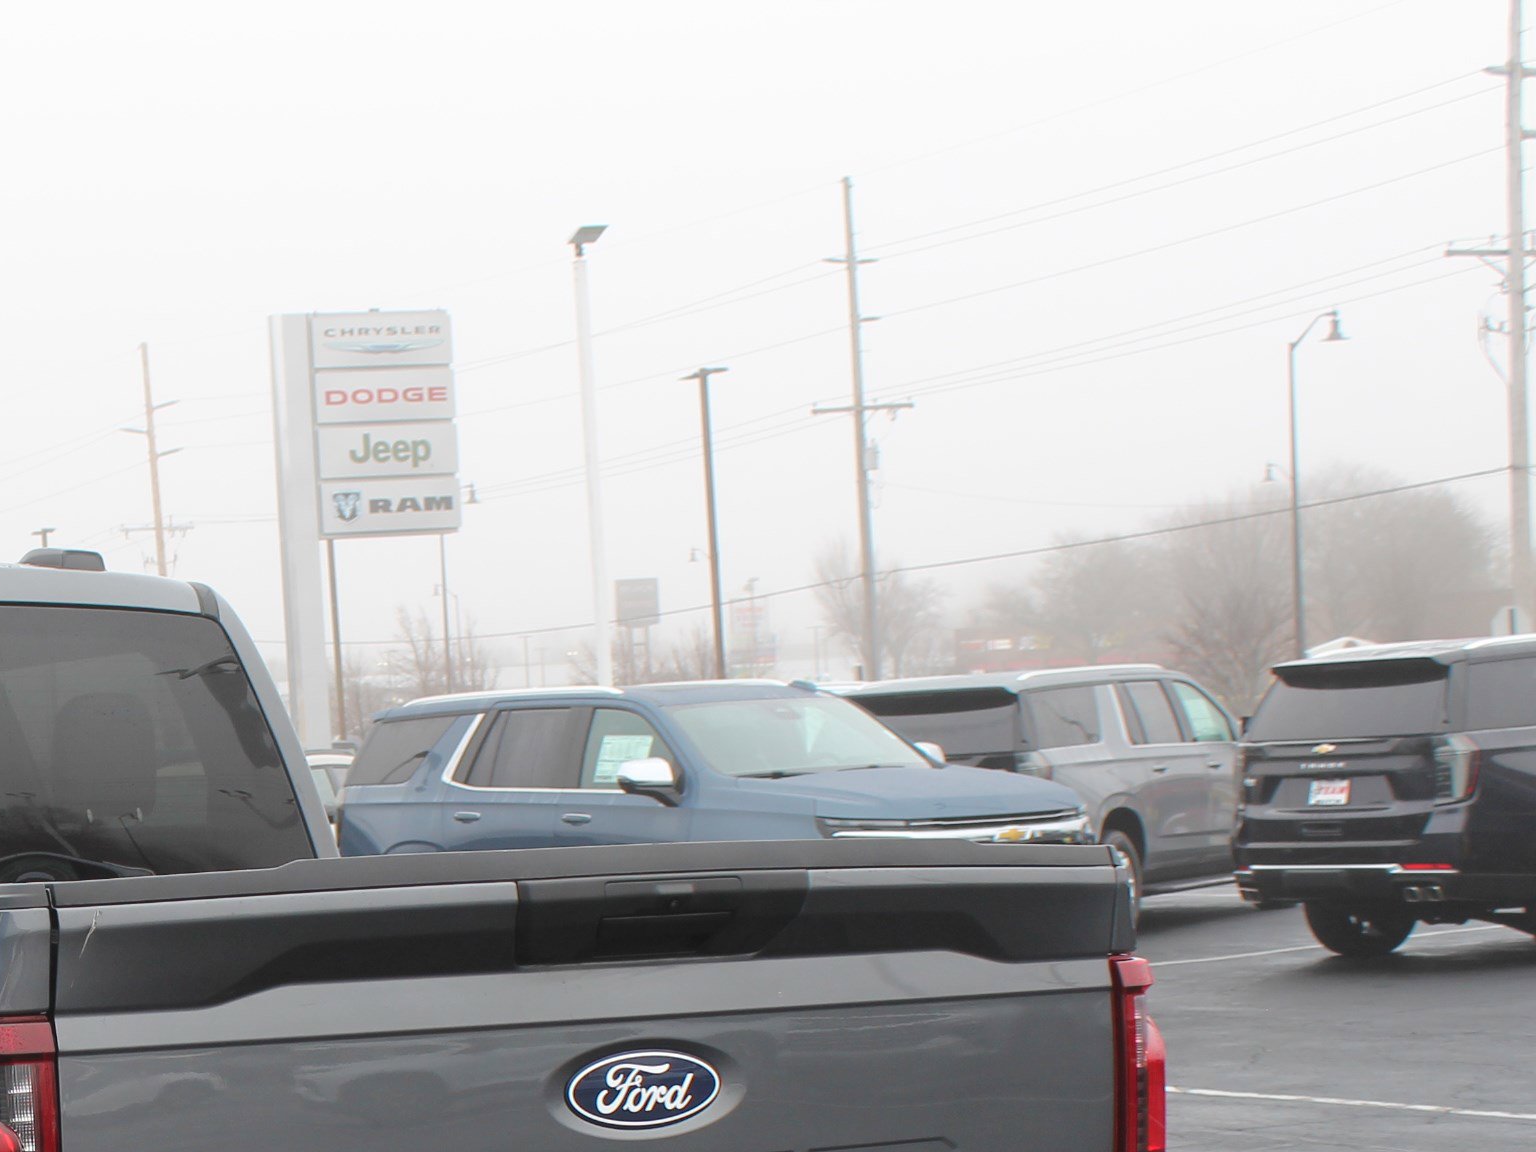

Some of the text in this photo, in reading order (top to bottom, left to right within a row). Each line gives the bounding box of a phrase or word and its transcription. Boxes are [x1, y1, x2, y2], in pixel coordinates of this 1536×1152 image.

[323, 325, 442, 338] CHRYSLER
[324, 386, 448, 406] DODGE
[349, 432, 432, 468] Jeep
[369, 495, 454, 514] RAM
[595, 1062, 695, 1115] Ford
